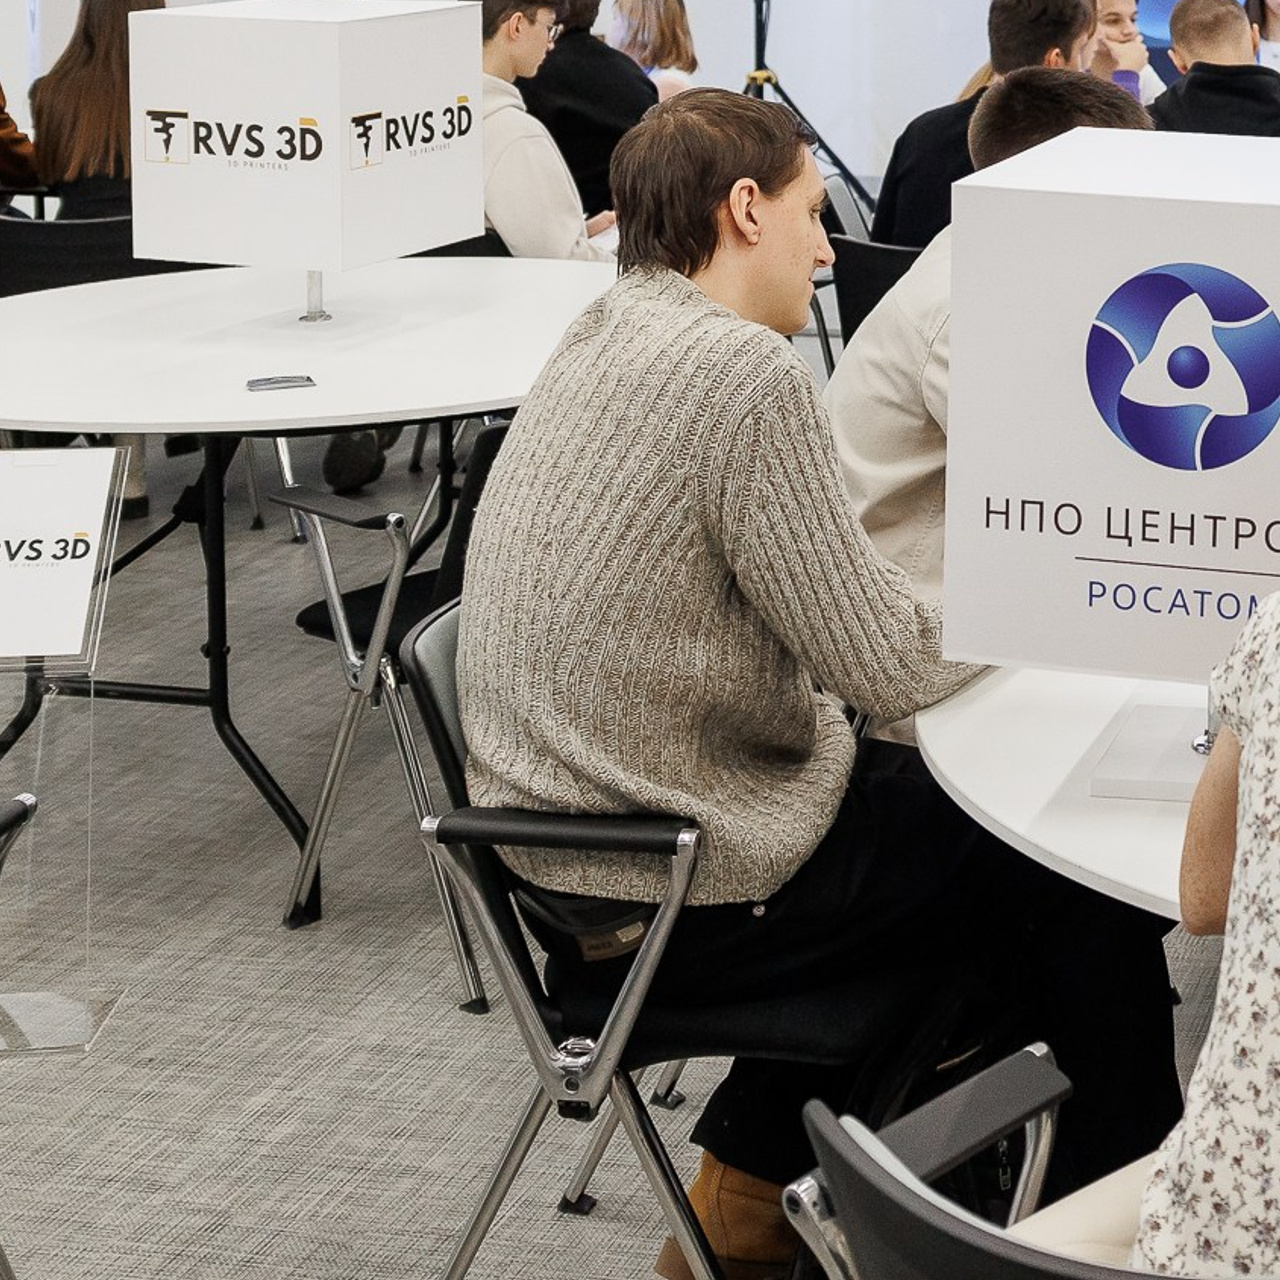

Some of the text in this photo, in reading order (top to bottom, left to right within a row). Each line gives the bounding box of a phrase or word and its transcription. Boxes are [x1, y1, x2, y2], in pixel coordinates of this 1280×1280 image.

[193, 121, 323, 161] RVS 3D
[385, 104, 472, 152] RVS 3D
[984, 496, 1083, 536] НПО
[0, 537, 92, 562] VS 3D
